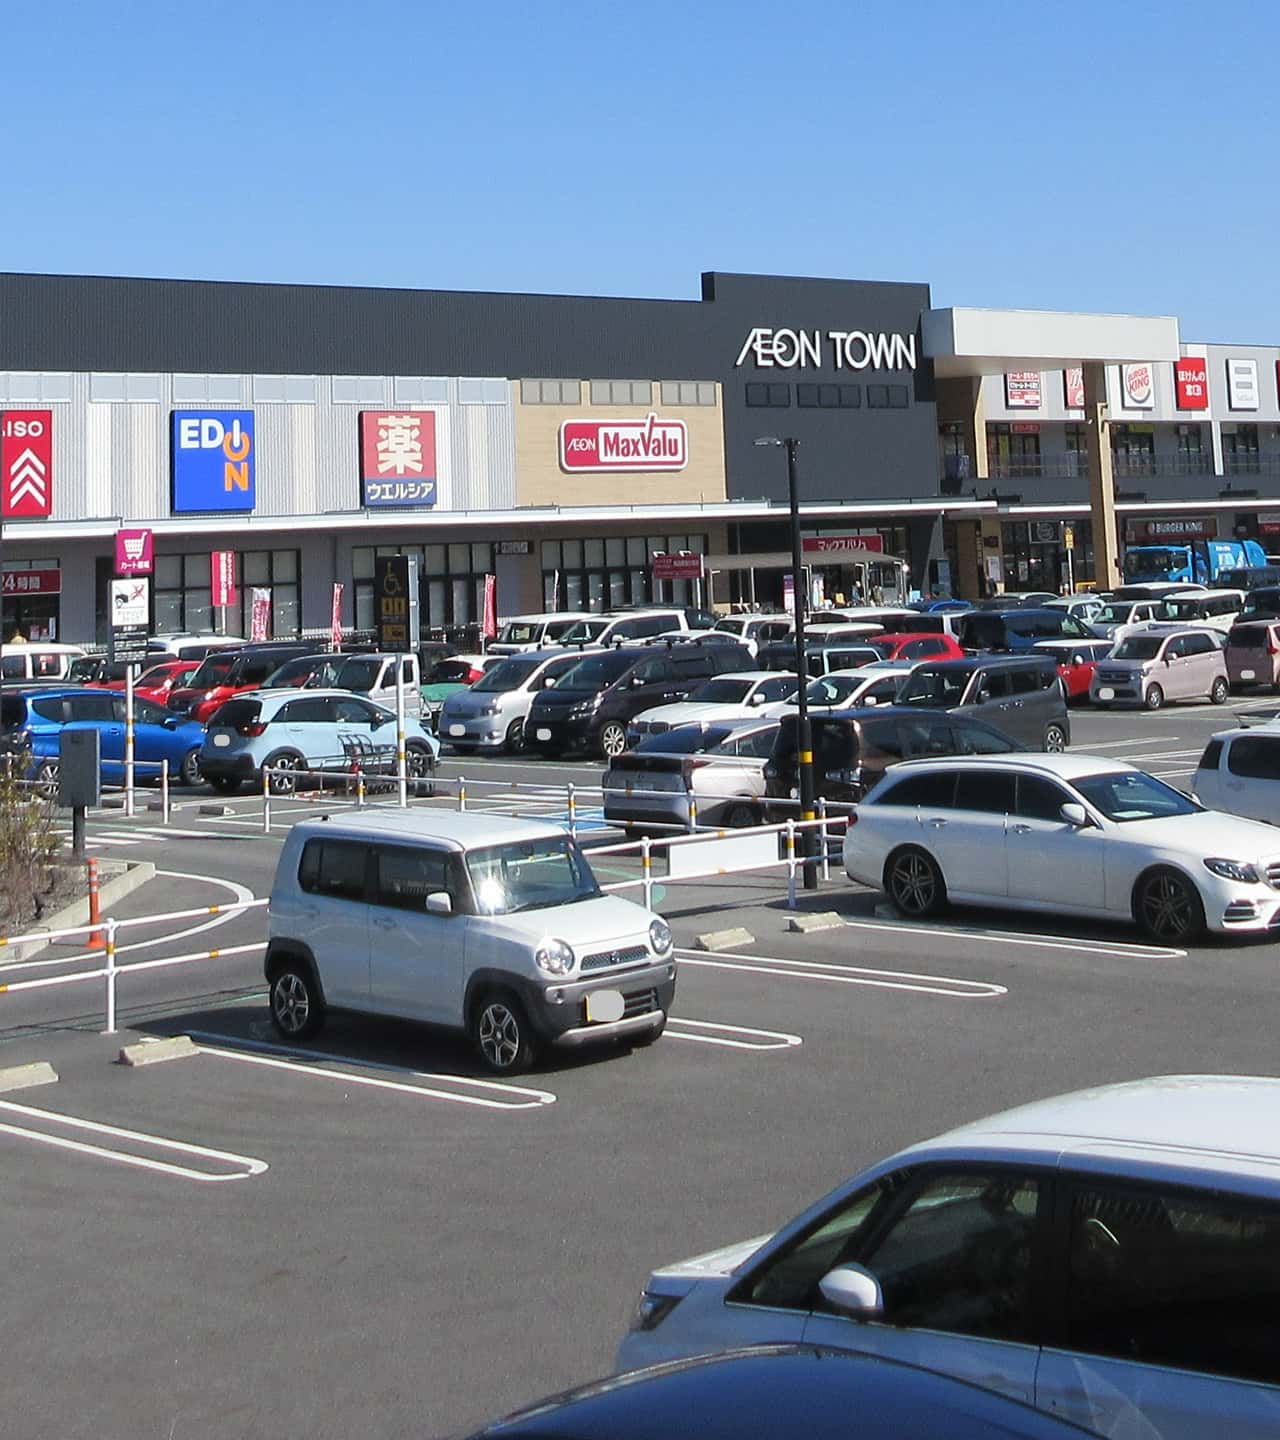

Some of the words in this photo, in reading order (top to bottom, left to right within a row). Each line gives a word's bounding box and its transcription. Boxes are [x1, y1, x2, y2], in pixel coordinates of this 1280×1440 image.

[829, 330, 917, 371] TOWN
[1128, 375, 1150, 394] KING
[2, 420, 44, 437] ISO
[603, 415, 679, 458] MaxValu
[376, 415, 423, 474] 薬
[367, 482, 434, 501] ウエルシア
